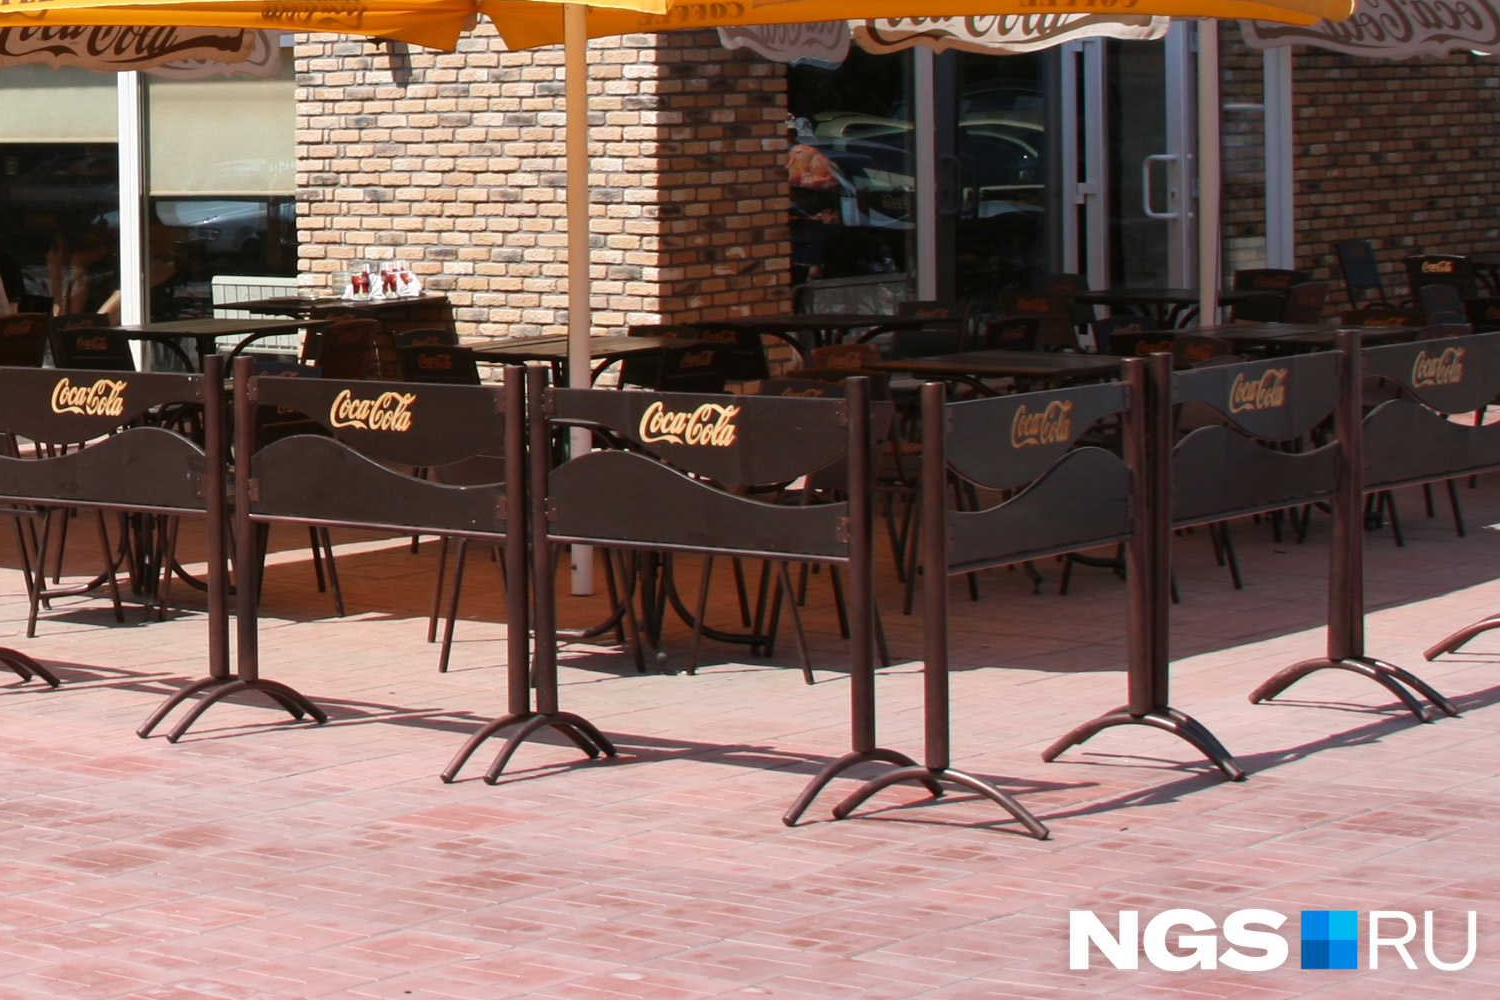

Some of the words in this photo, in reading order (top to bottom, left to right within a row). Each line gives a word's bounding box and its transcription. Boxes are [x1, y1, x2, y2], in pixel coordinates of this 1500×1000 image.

[51, 377, 128, 416] Coca-Cola
[329, 389, 416, 431] Coca-Cola
[638, 401, 742, 447] Coca-Cola
[1011, 400, 1073, 448] Coca-Cola
